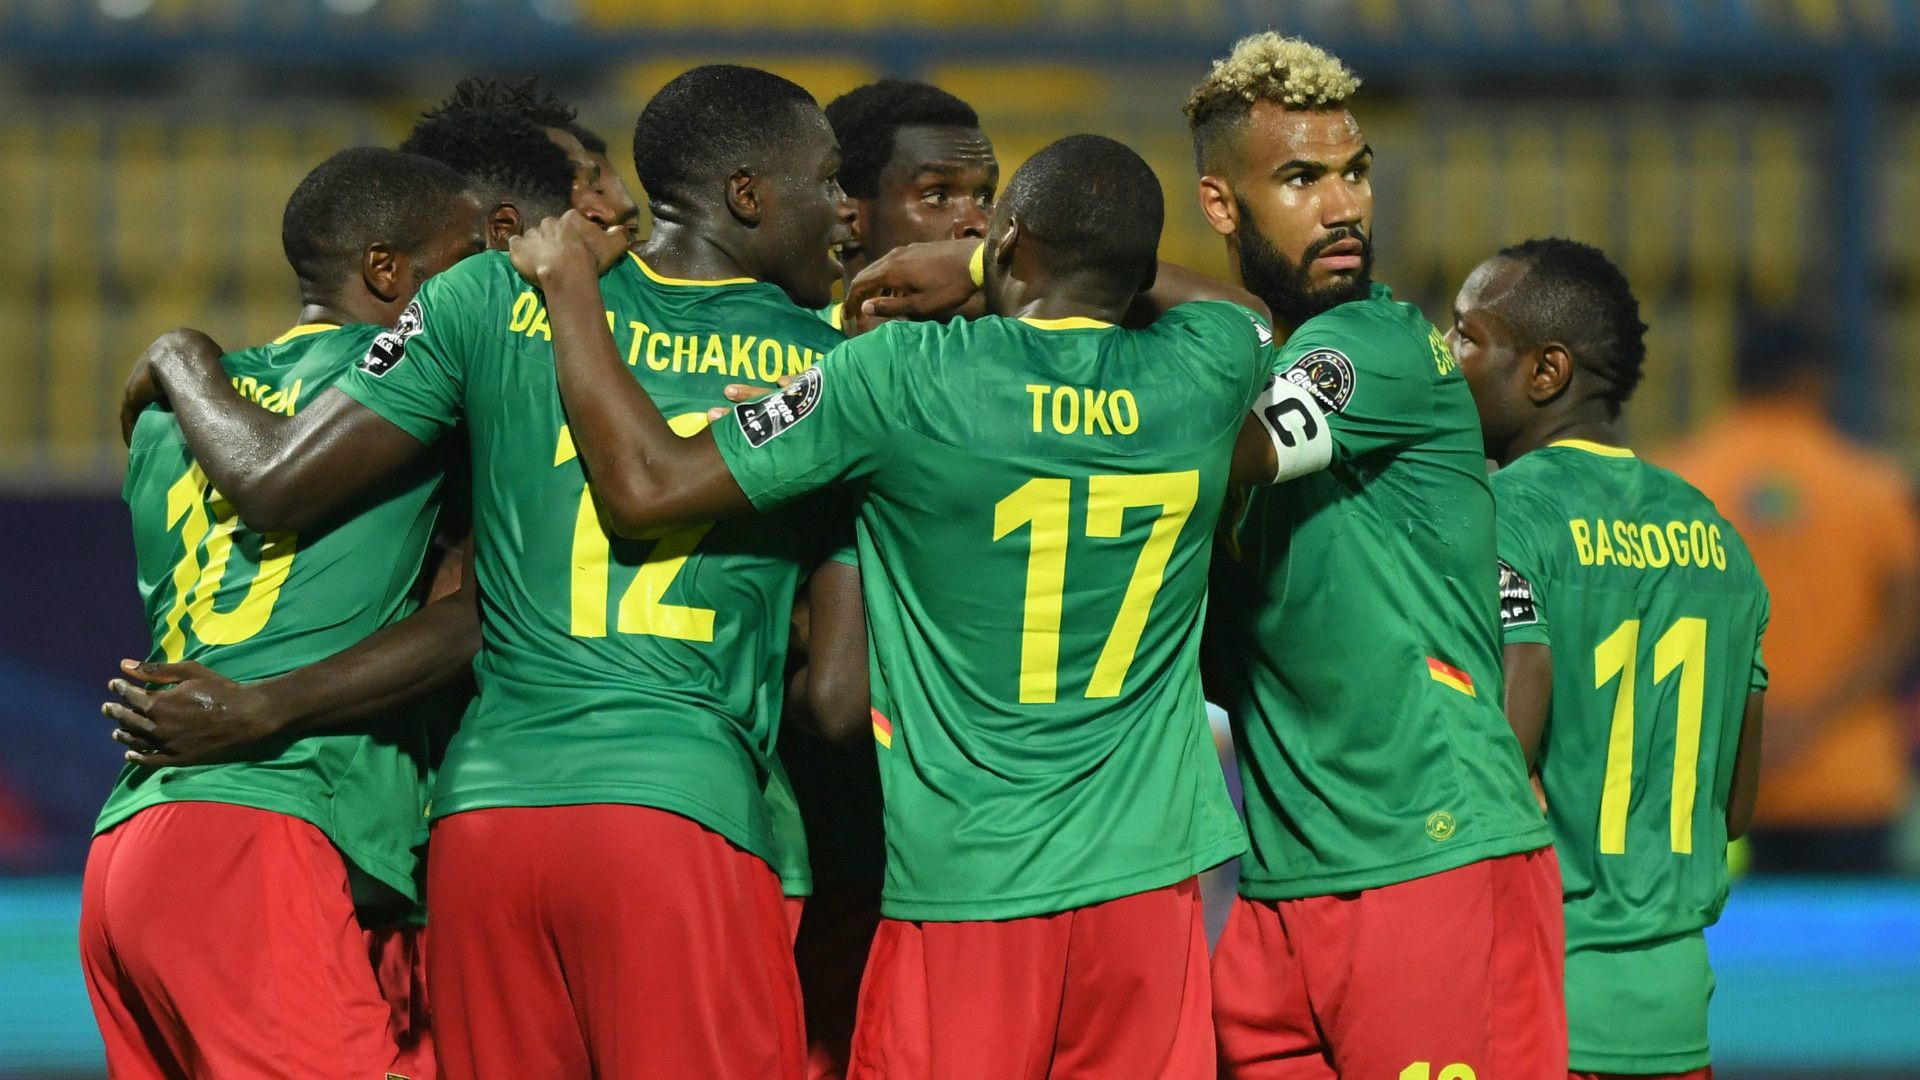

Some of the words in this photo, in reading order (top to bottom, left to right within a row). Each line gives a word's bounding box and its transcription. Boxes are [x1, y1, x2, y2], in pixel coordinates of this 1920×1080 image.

[627, 320, 825, 383] TCHAKON
[1026, 384, 1139, 435] TOKO
[1264, 397, 1318, 448] C
[161, 462, 298, 664] 10
[555, 412, 717, 643] 12
[993, 469, 1200, 704] 17
[1569, 518, 1728, 572] BASSOGOG
[1594, 617, 1708, 855] 11
